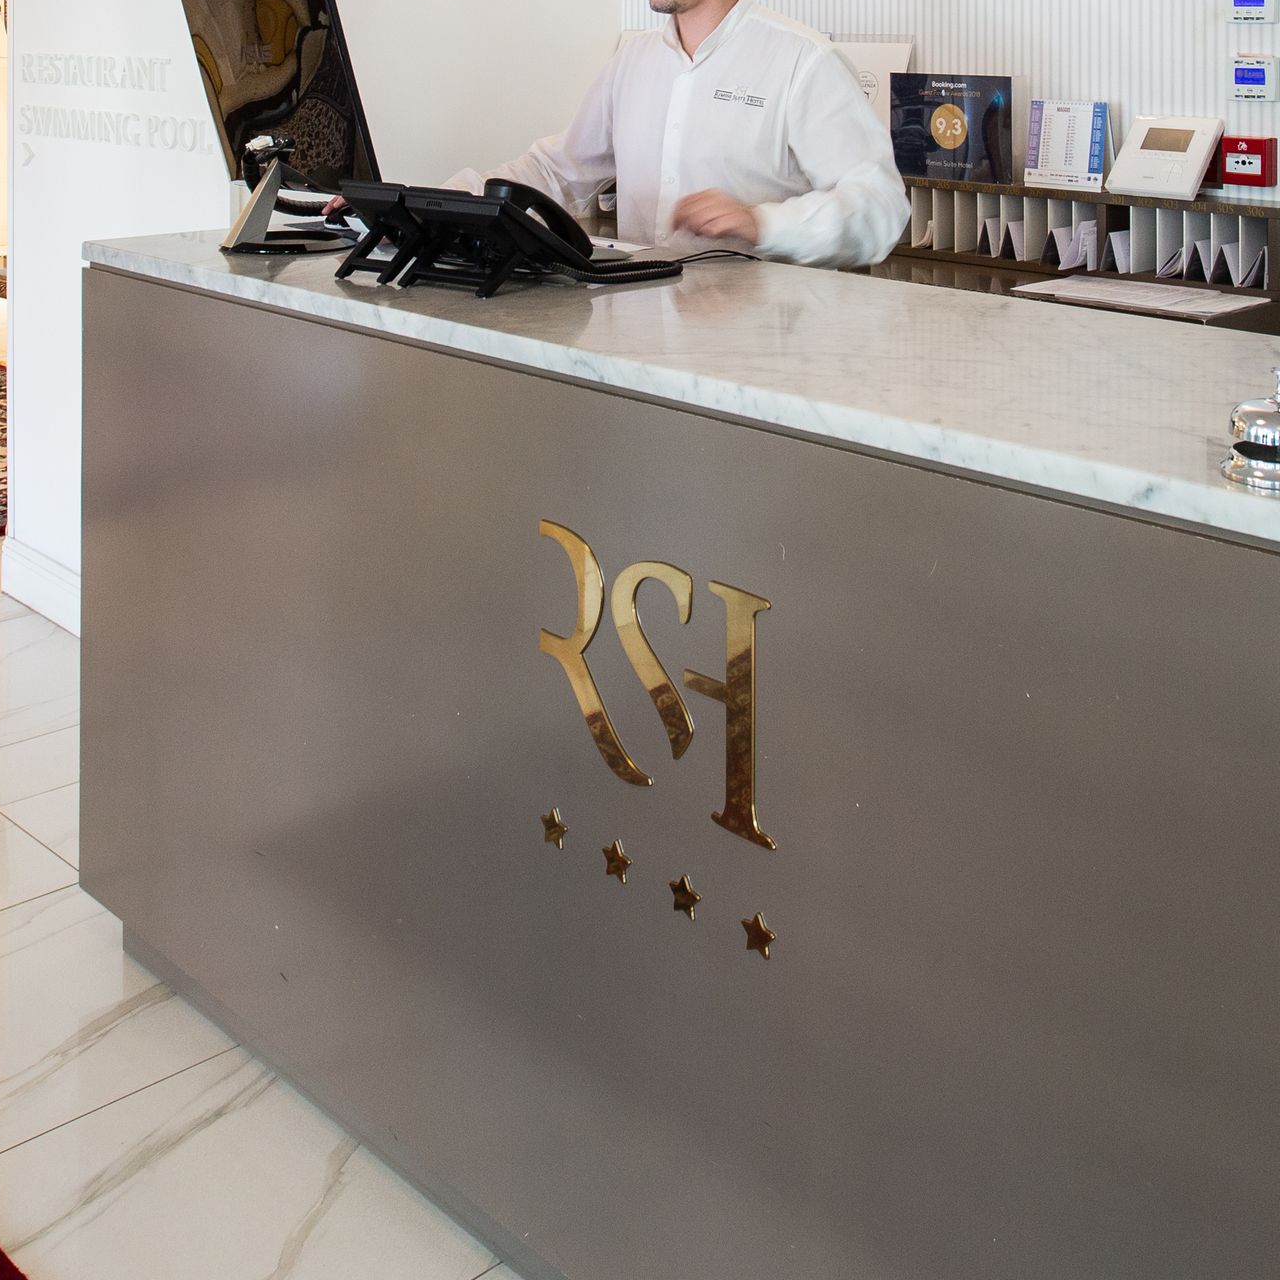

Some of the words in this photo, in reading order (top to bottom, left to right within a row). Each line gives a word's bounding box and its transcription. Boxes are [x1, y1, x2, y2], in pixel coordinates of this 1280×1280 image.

[20, 52, 172, 93] RESTAURANT
[931, 80, 968, 89] Booking.com
[19, 104, 142, 146] SWIMMING
[146, 115, 215, 155] POOL
[935, 117, 962, 137] 9,3
[1246, 206, 1265, 218] 306
